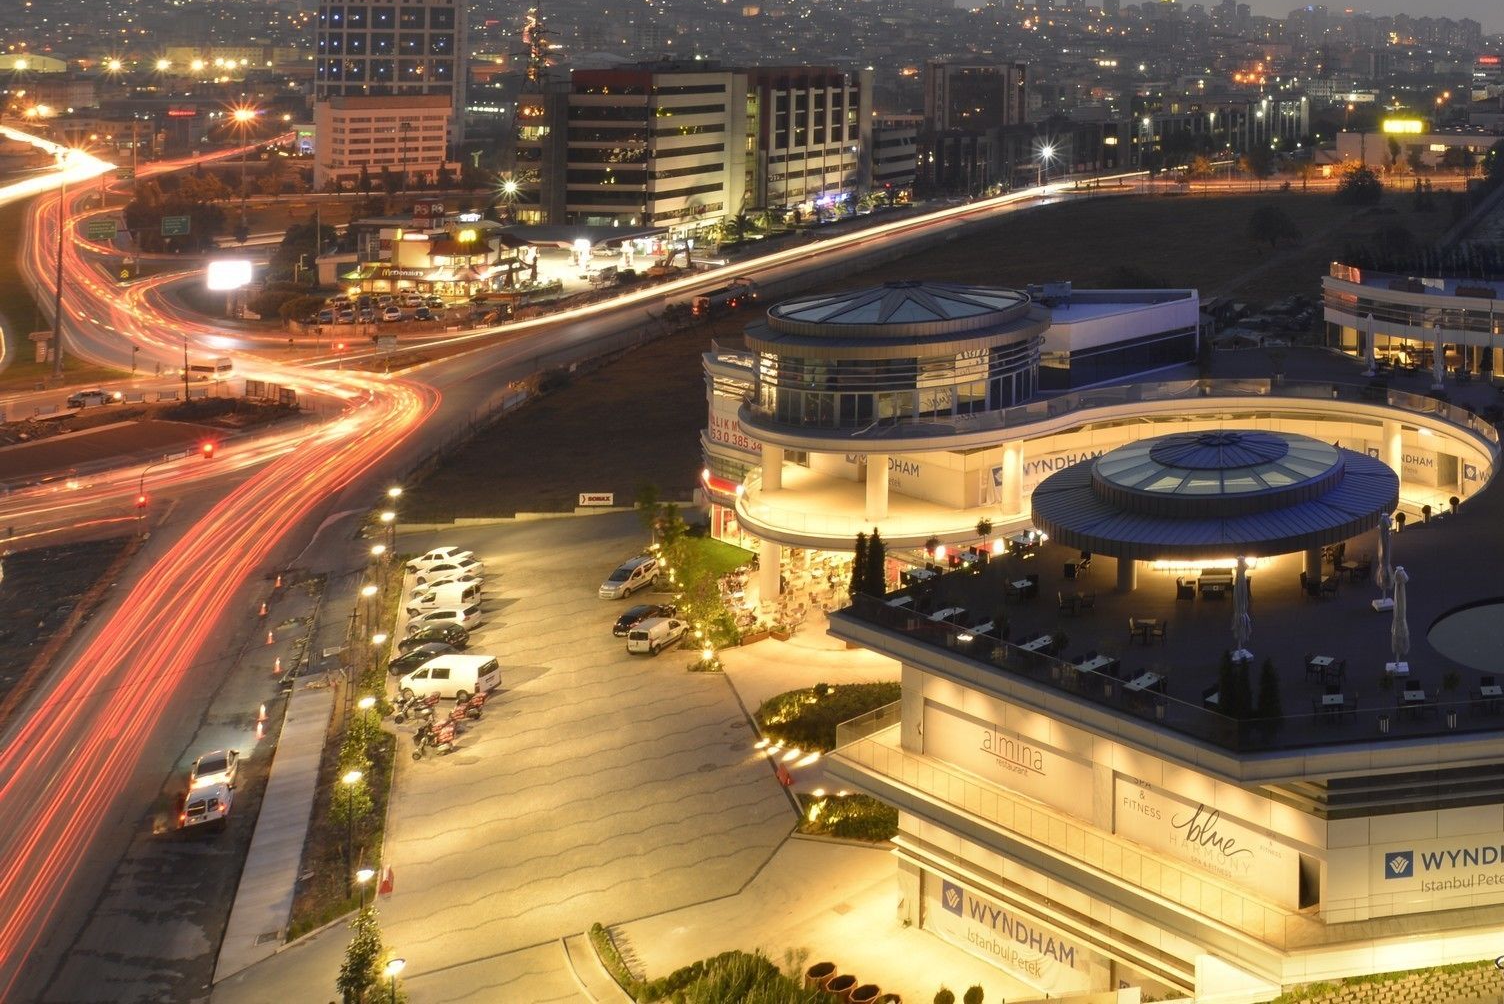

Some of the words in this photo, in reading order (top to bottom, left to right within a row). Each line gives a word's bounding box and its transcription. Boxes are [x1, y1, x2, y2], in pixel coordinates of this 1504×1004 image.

[732, 434, 749, 448] 385
[984, 724, 1043, 770] almina
[996, 759, 1028, 776] restaurant
[1123, 797, 1162, 820] FITNESS
[1139, 790, 1146, 800] &
[1171, 803, 1255, 857] blue
[1169, 832, 1251, 877] HARMONY
[1421, 874, 1475, 893] Istanbul
[968, 896, 1075, 968] WYNDHAM
[967, 927, 1012, 961] Istanbul
[1011, 950, 1042, 979] Petek
